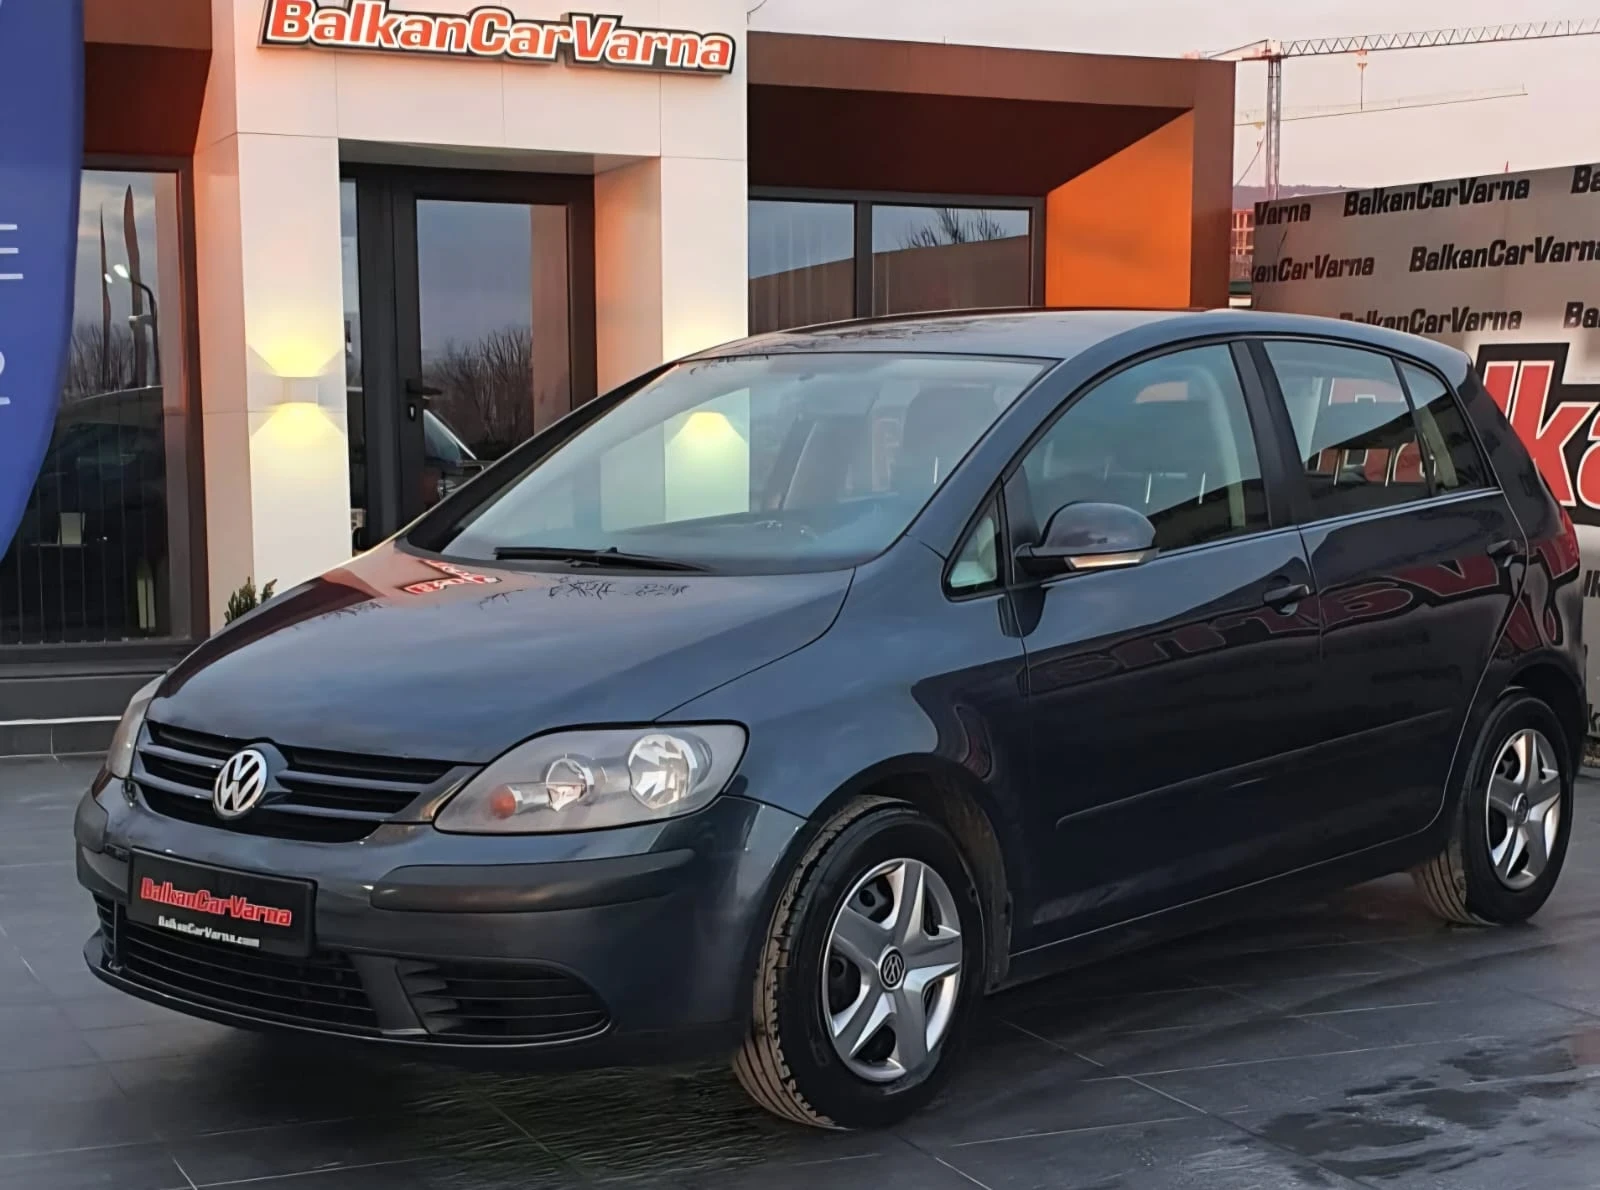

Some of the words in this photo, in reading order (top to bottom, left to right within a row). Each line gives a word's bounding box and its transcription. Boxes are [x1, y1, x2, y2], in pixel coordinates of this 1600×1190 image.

[267, 0, 732, 70] BalkanCarVarna
[1254, 201, 1311, 225] Varna
[1343, 176, 1530, 217] BalkanCarVarna
[141, 877, 292, 927] BalkanCarVarna
